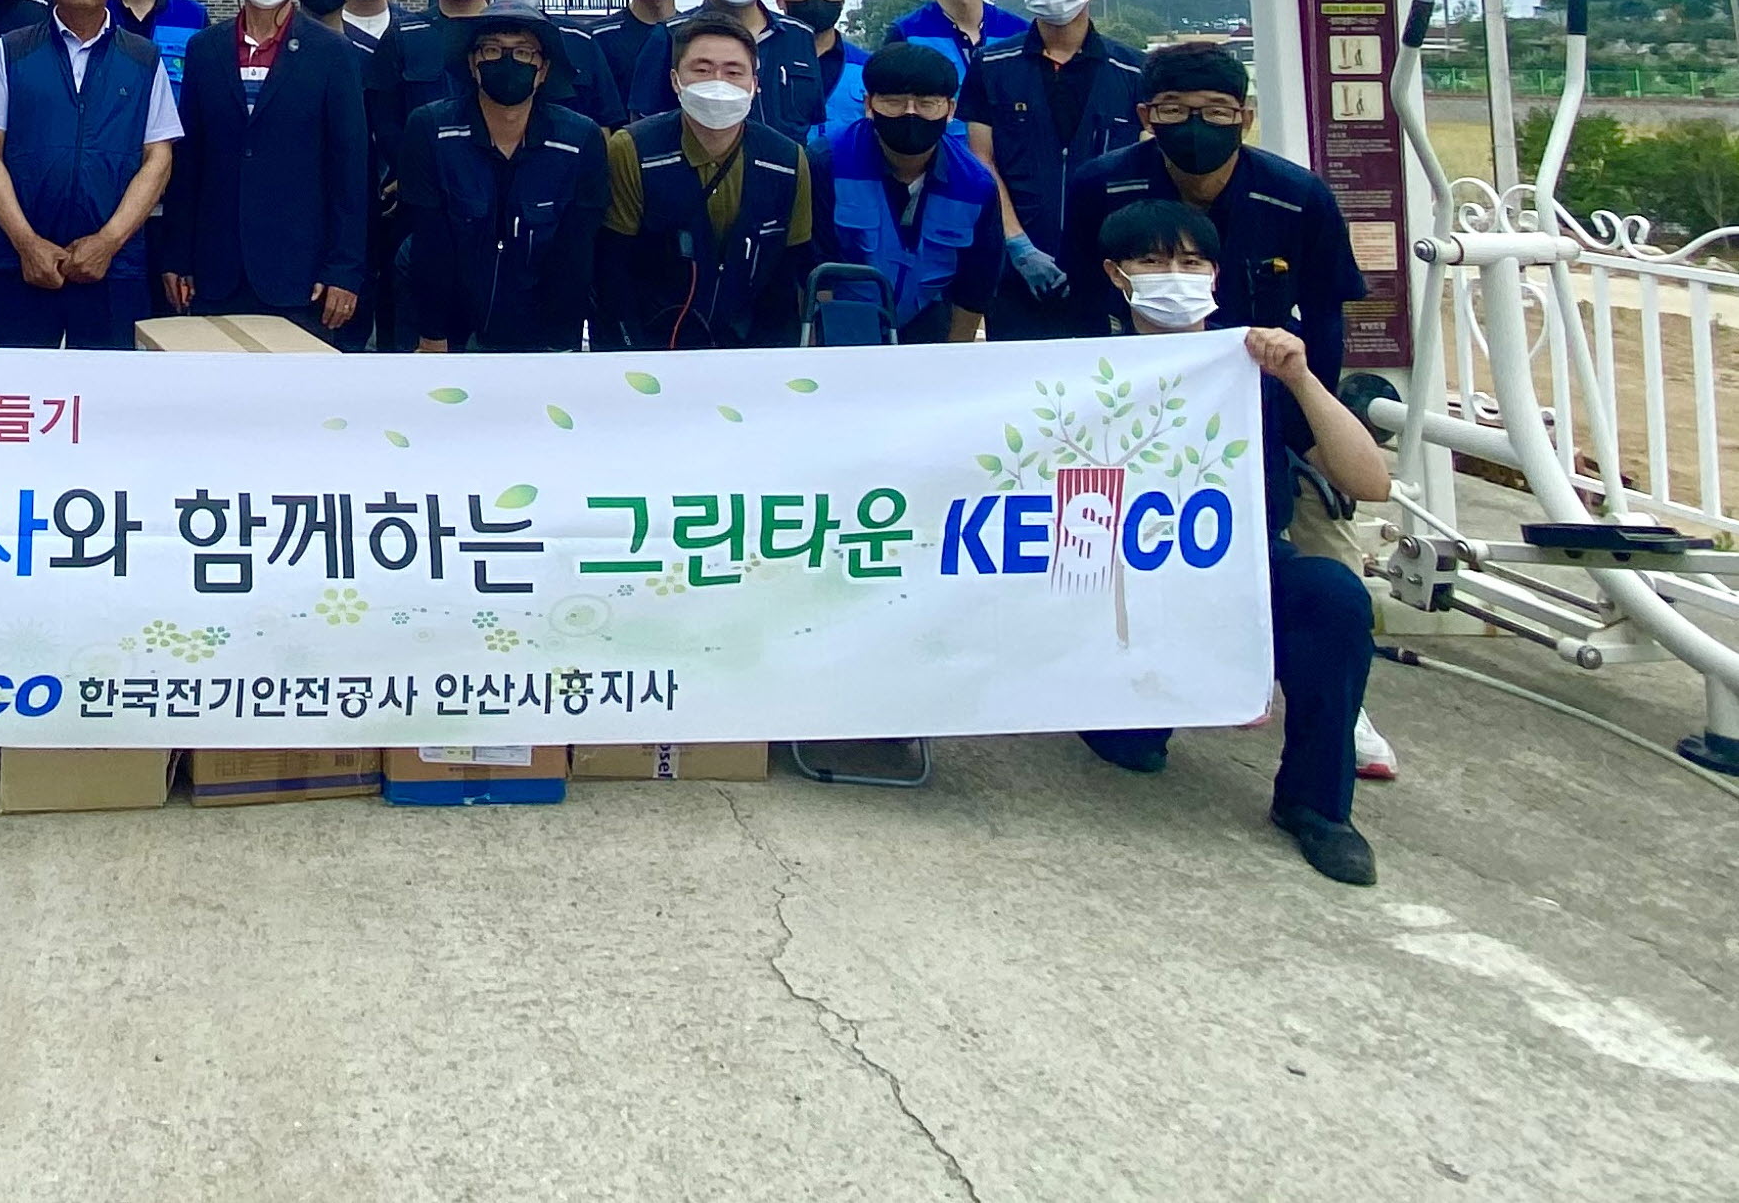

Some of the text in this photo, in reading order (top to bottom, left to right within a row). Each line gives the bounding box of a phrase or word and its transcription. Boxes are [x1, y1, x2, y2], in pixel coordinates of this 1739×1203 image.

[174, 488, 544, 593] 함께하는
[579, 488, 915, 587] 그린타운
[940, 468, 1233, 592] KESCO
[79, 669, 679, 719] 한국전기안전공사 안산시흥지사
